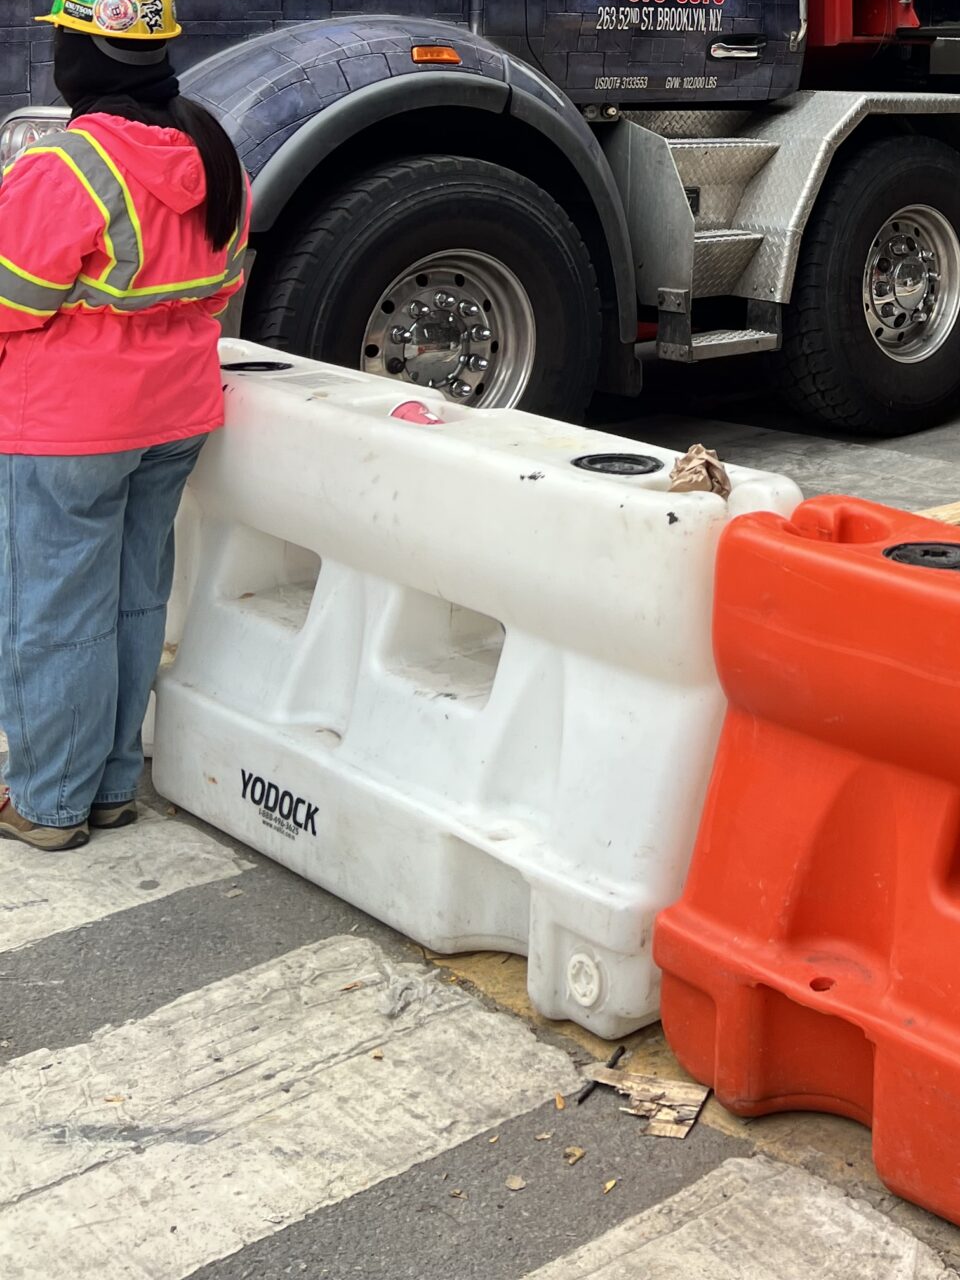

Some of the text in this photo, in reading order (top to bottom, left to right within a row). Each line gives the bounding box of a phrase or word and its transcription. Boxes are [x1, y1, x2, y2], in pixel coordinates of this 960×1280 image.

[596, 6, 616, 30] 263
[640, 7, 654, 31] ST.
[656, 7, 707, 35] BROOKLYN,
[708, 8, 723, 32] N.Y.
[594, 76, 718, 90] USDOT# 3133553 GVW: 102,000 LBS
[240, 768, 320, 837] YODOCK
